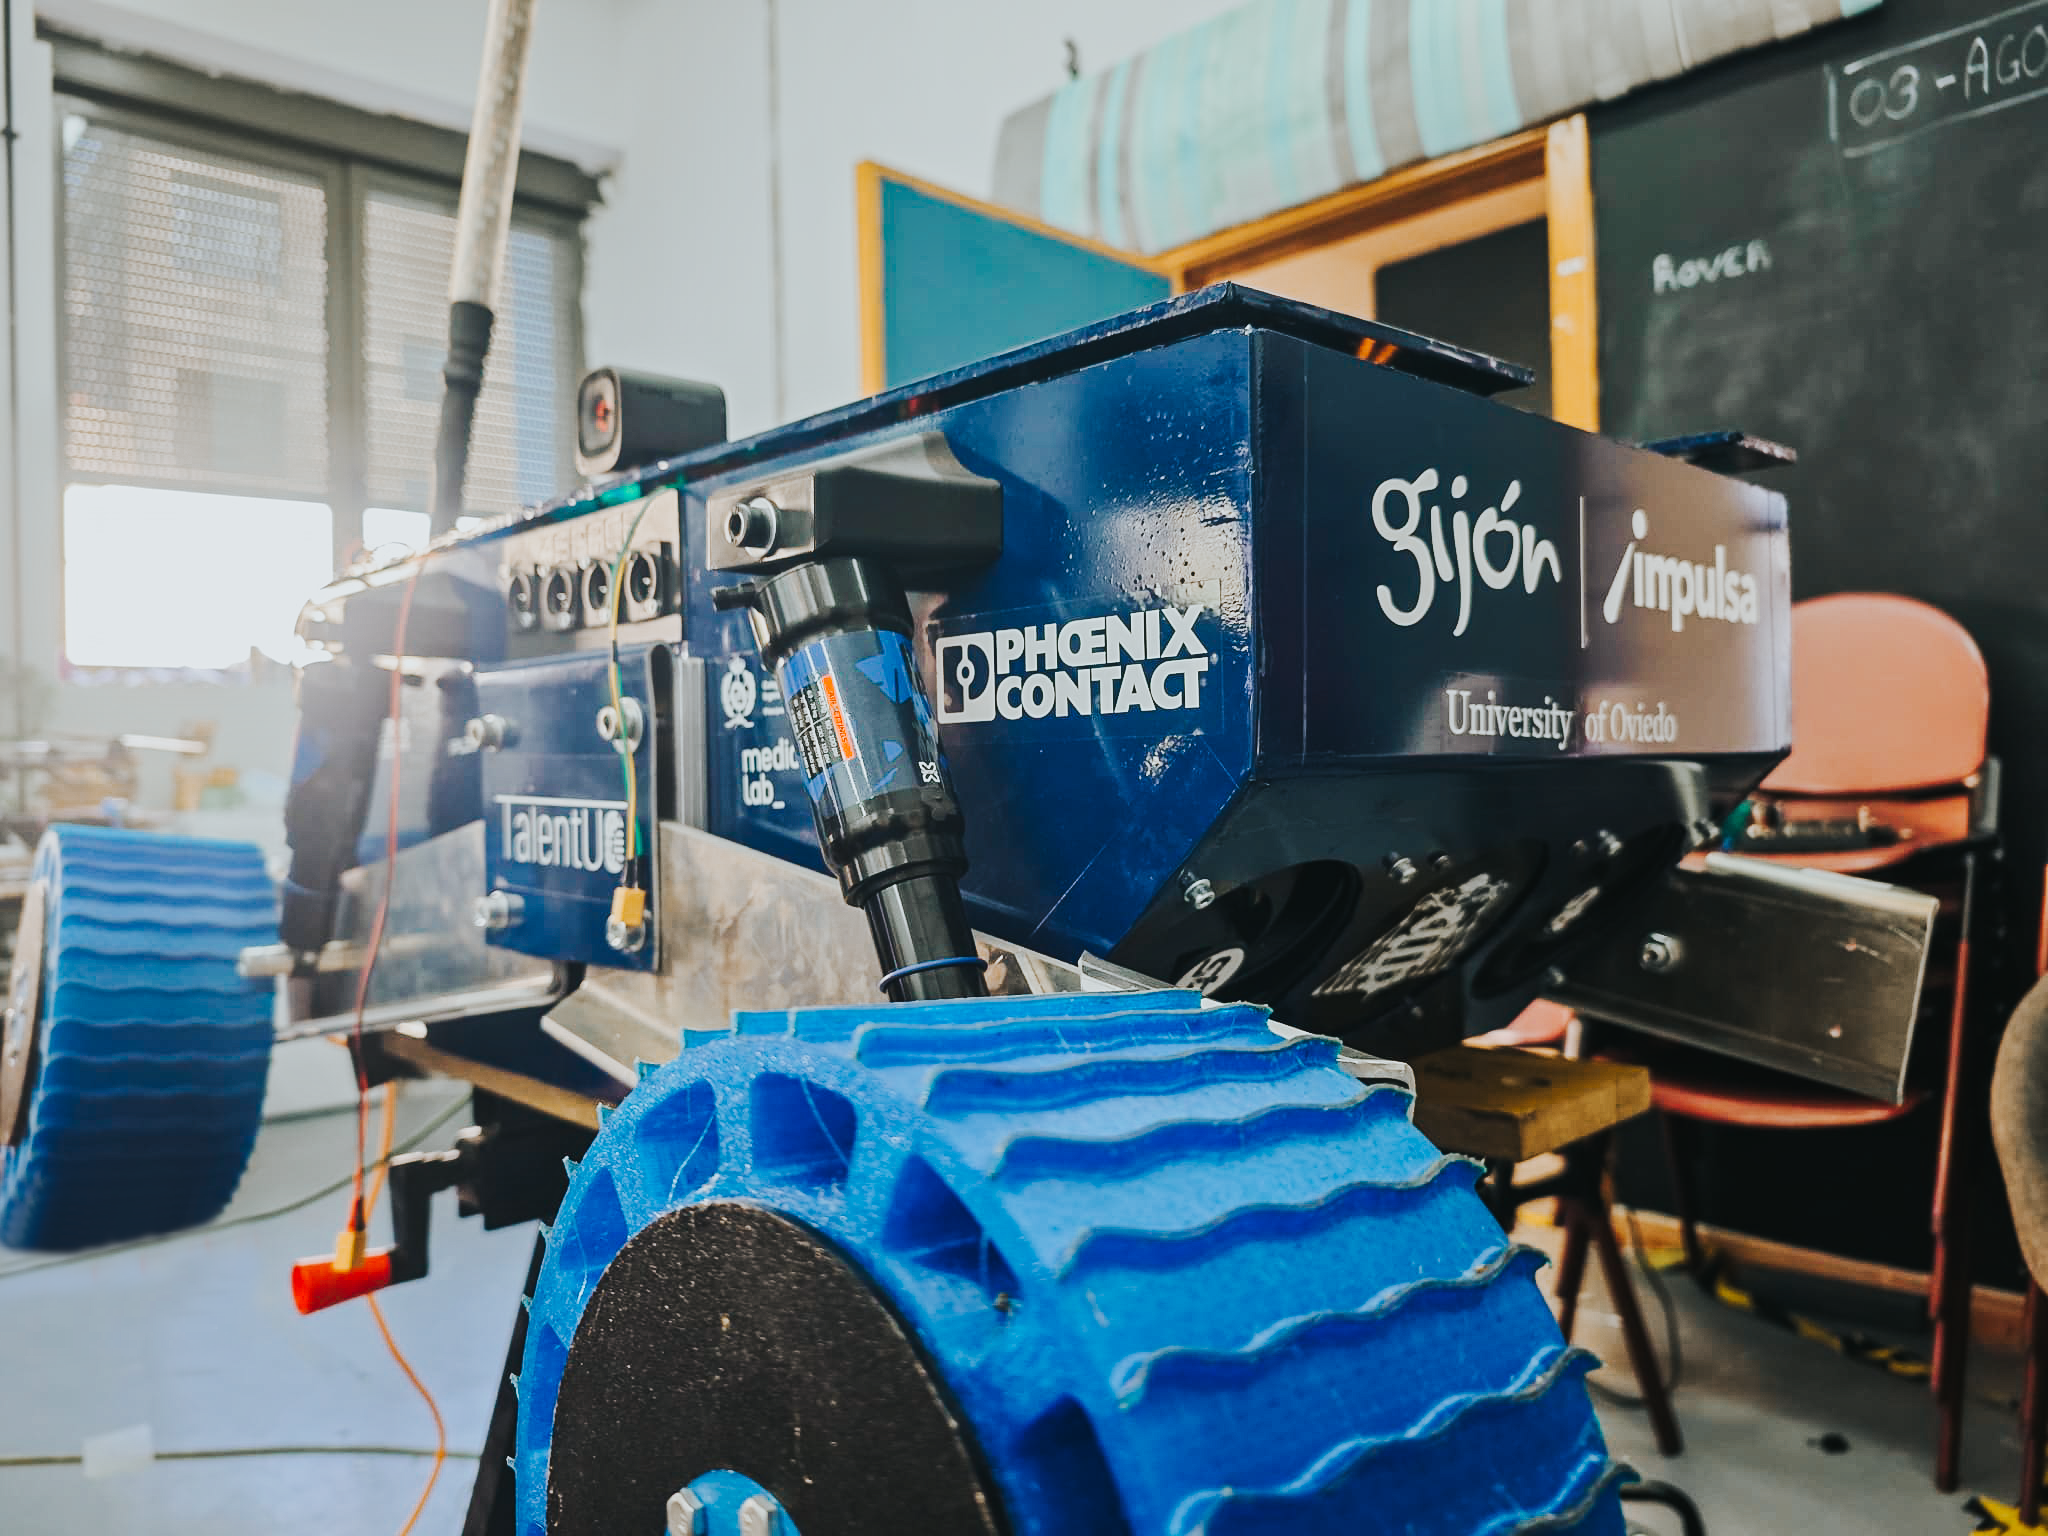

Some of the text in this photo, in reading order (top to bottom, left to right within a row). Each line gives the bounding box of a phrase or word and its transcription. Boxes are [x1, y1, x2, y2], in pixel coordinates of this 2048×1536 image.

[1372, 468, 1760, 637] gijón impulsa
[996, 657, 1209, 721] CONTACT
[1446, 688, 1678, 751] University of Oviedo
